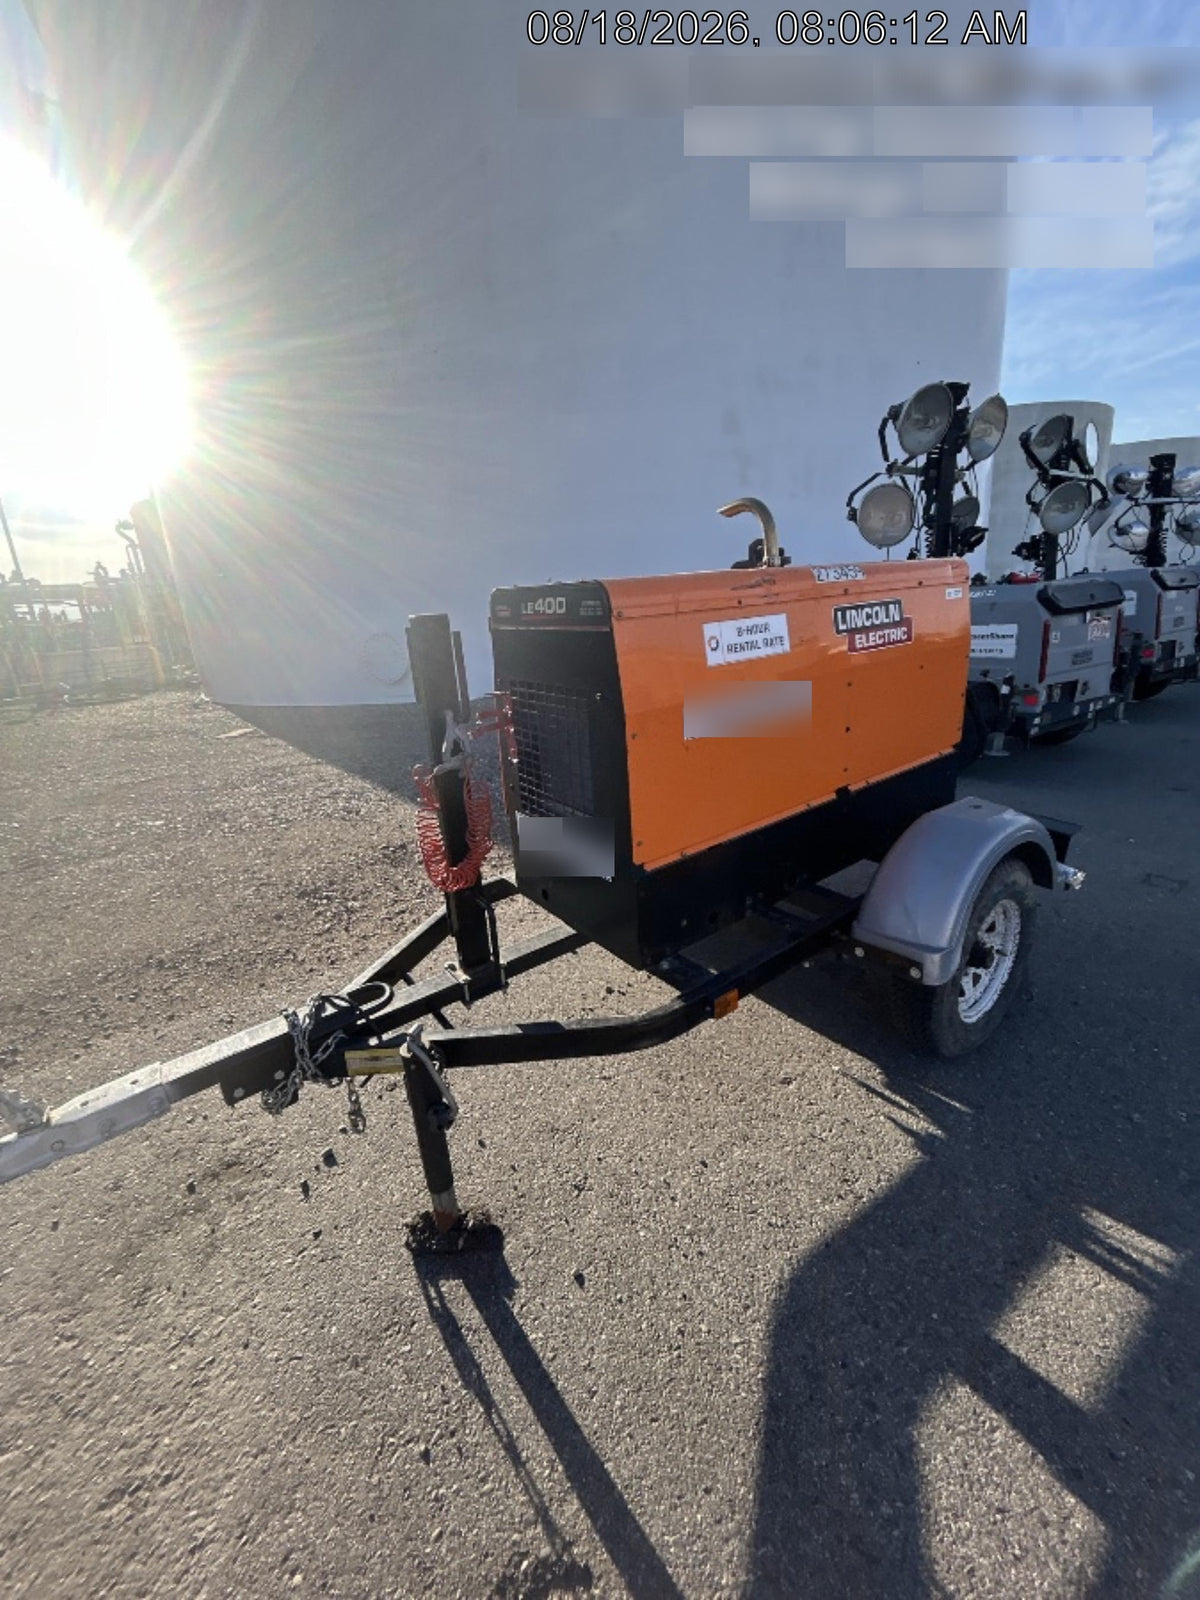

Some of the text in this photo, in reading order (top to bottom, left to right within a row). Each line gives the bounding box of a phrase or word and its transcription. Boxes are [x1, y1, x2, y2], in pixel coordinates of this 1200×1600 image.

[836, 603, 900, 630] LINCOLN
[736, 622, 771, 638] 8-HOUR
[854, 627, 908, 649] ELECTRIC
[726, 635, 785, 654] RENTAL RATE
